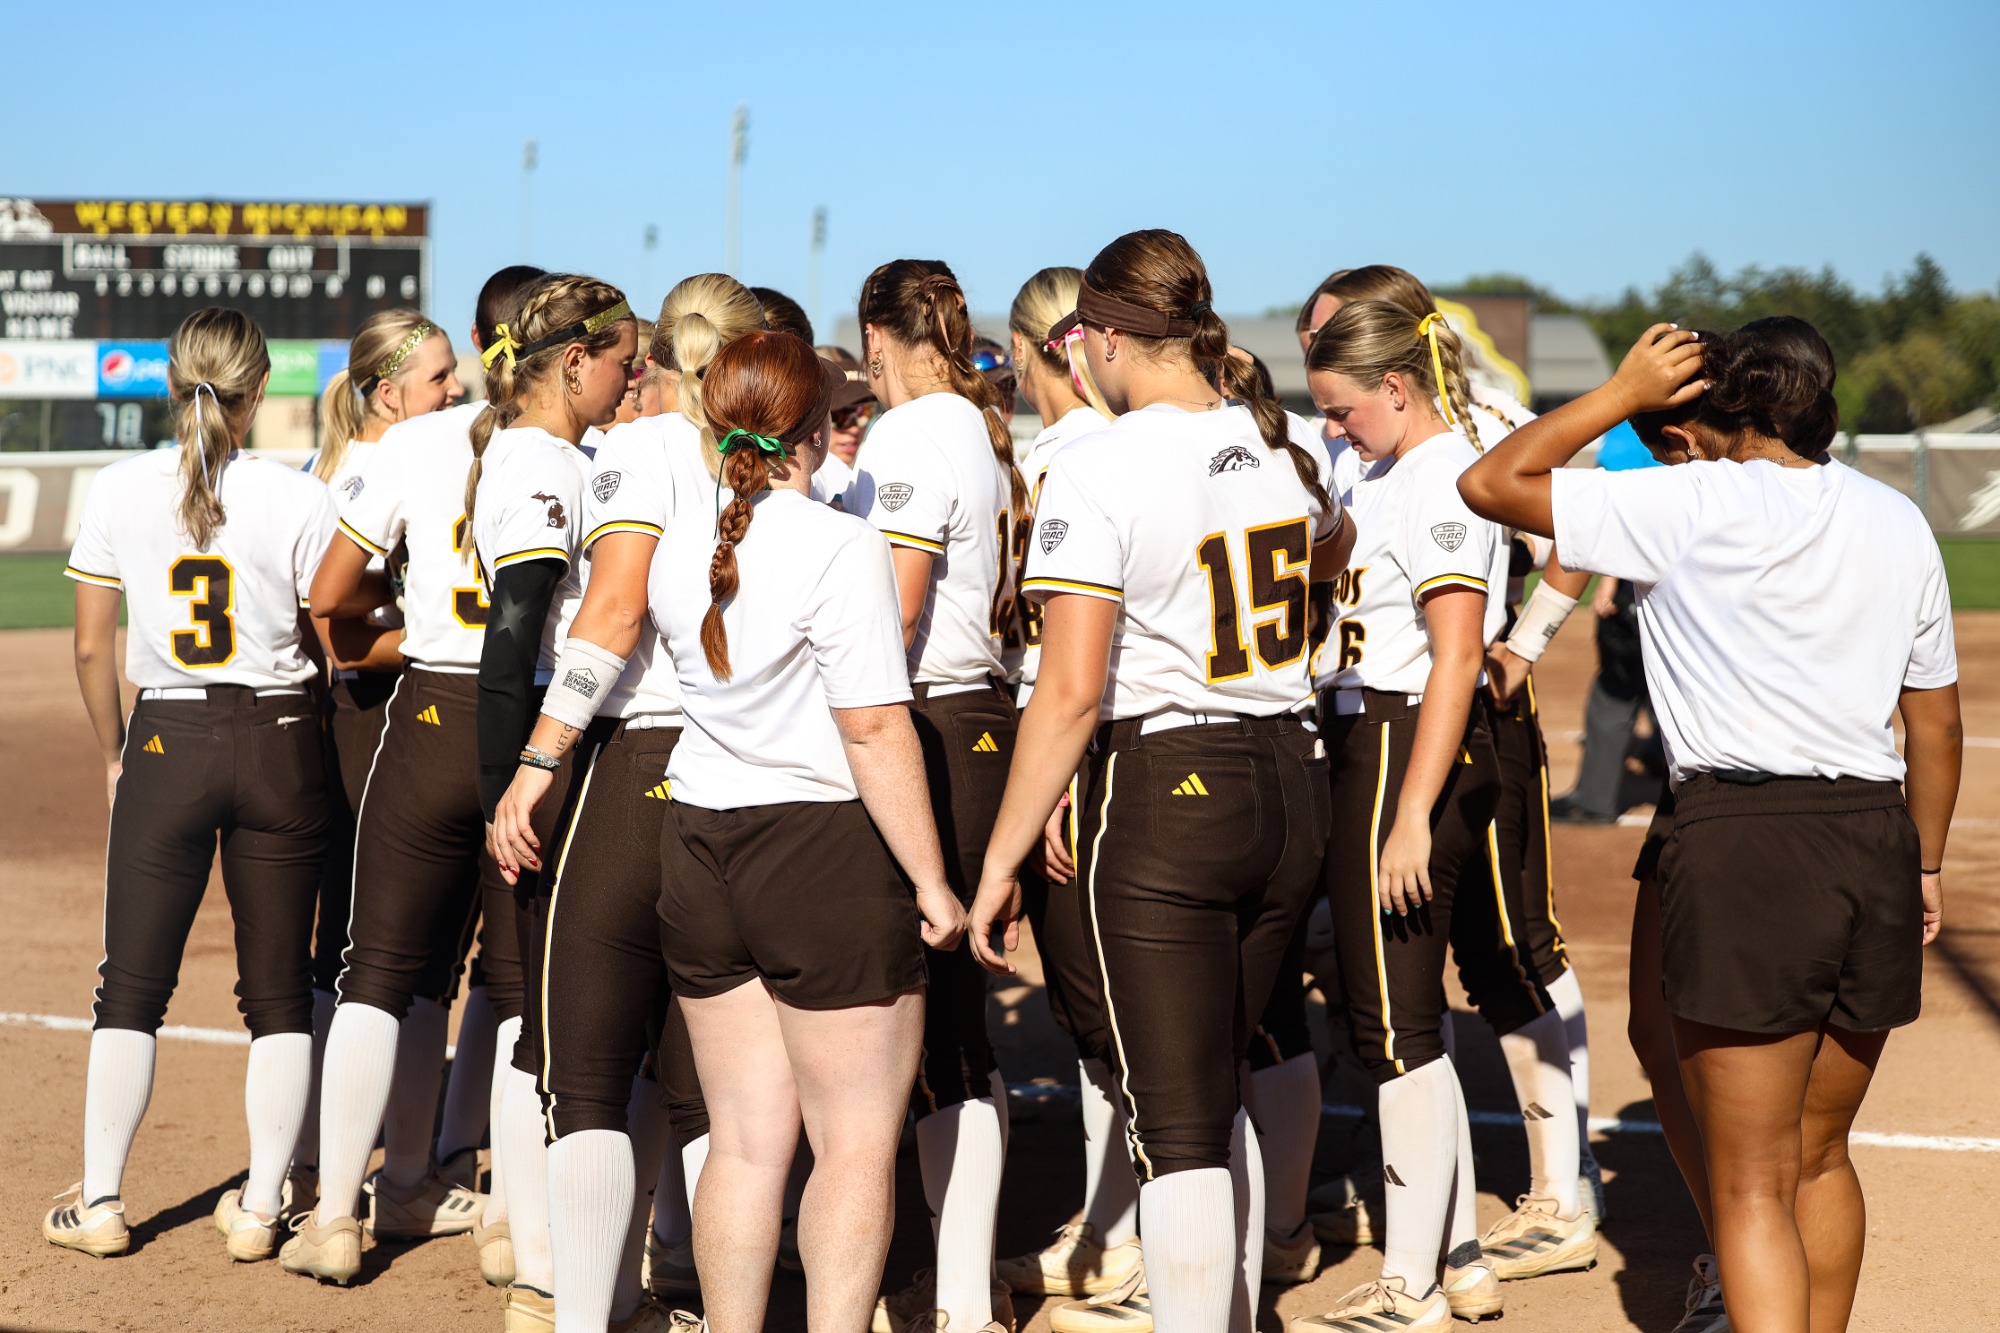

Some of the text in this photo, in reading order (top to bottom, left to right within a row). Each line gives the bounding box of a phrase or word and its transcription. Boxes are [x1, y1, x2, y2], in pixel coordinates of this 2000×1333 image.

[75, 201, 407, 231] WESTERN MICHIGAN
[1041, 531, 1063, 540] MAC
[1436, 532, 1463, 540] MAC
[168, 555, 237, 669] 3
[1196, 516, 1312, 685] 15
[556, 732, 568, 751] LET
